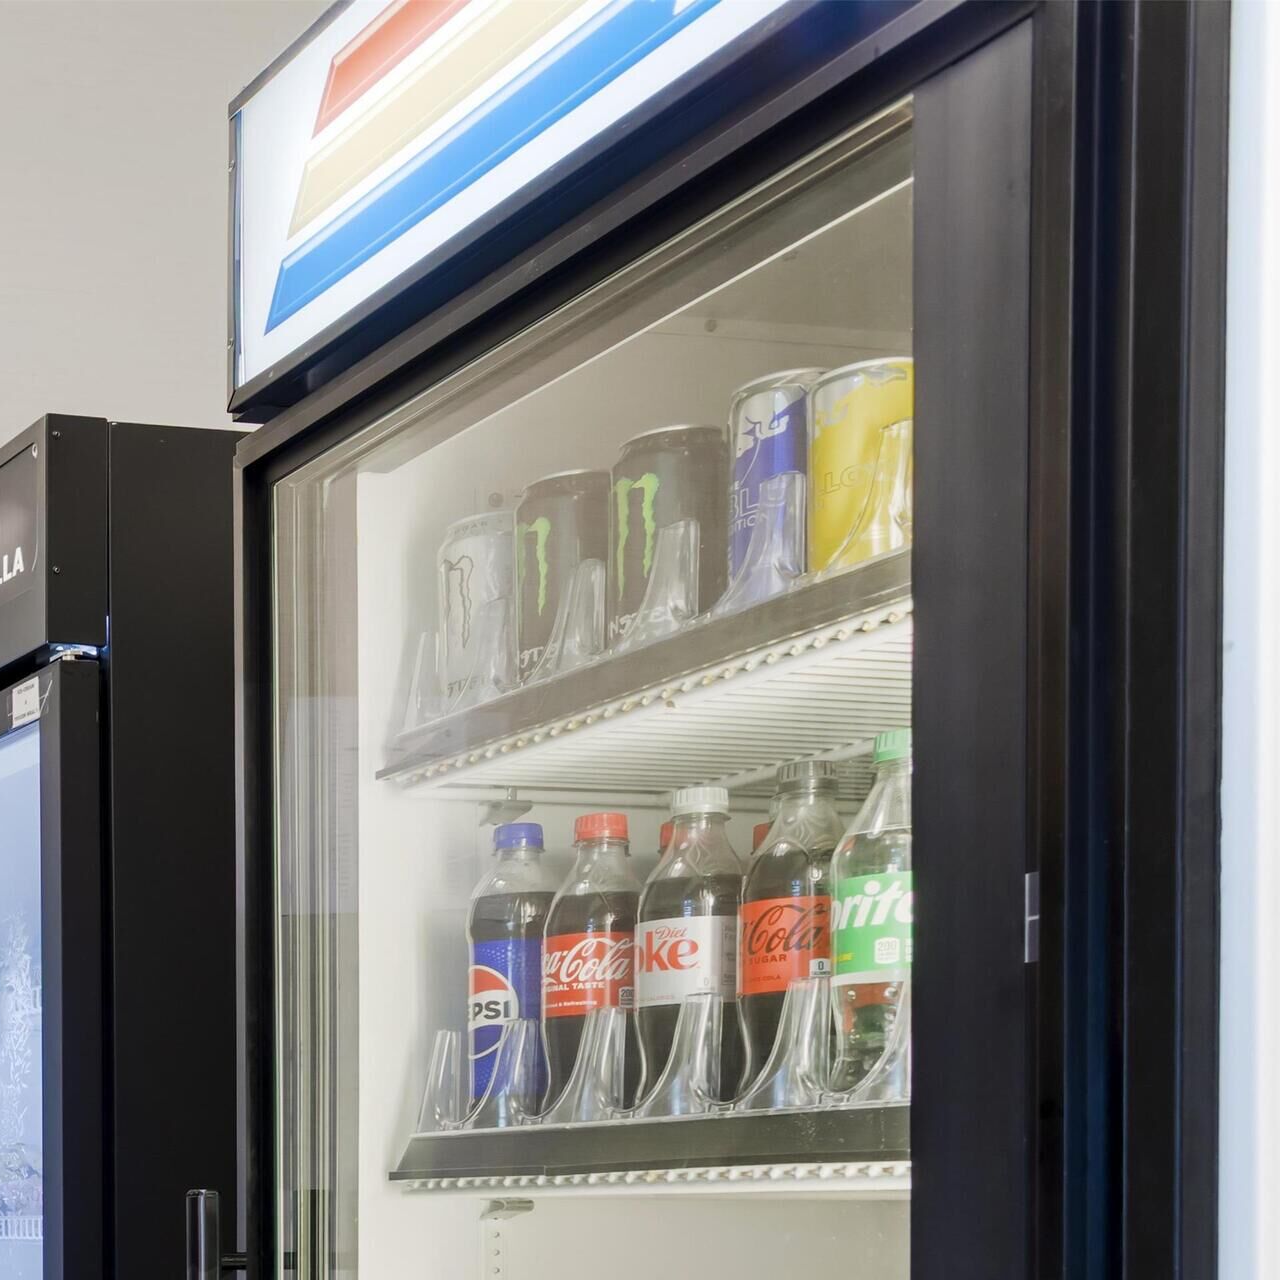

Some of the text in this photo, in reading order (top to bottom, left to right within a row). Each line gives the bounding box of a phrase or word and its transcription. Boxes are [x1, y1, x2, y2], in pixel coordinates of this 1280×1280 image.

[654, 925, 688, 940] Diet
[749, 954, 787, 965] SUGAR
[572, 980, 607, 991] TASTE
[471, 999, 511, 1021] PSI
